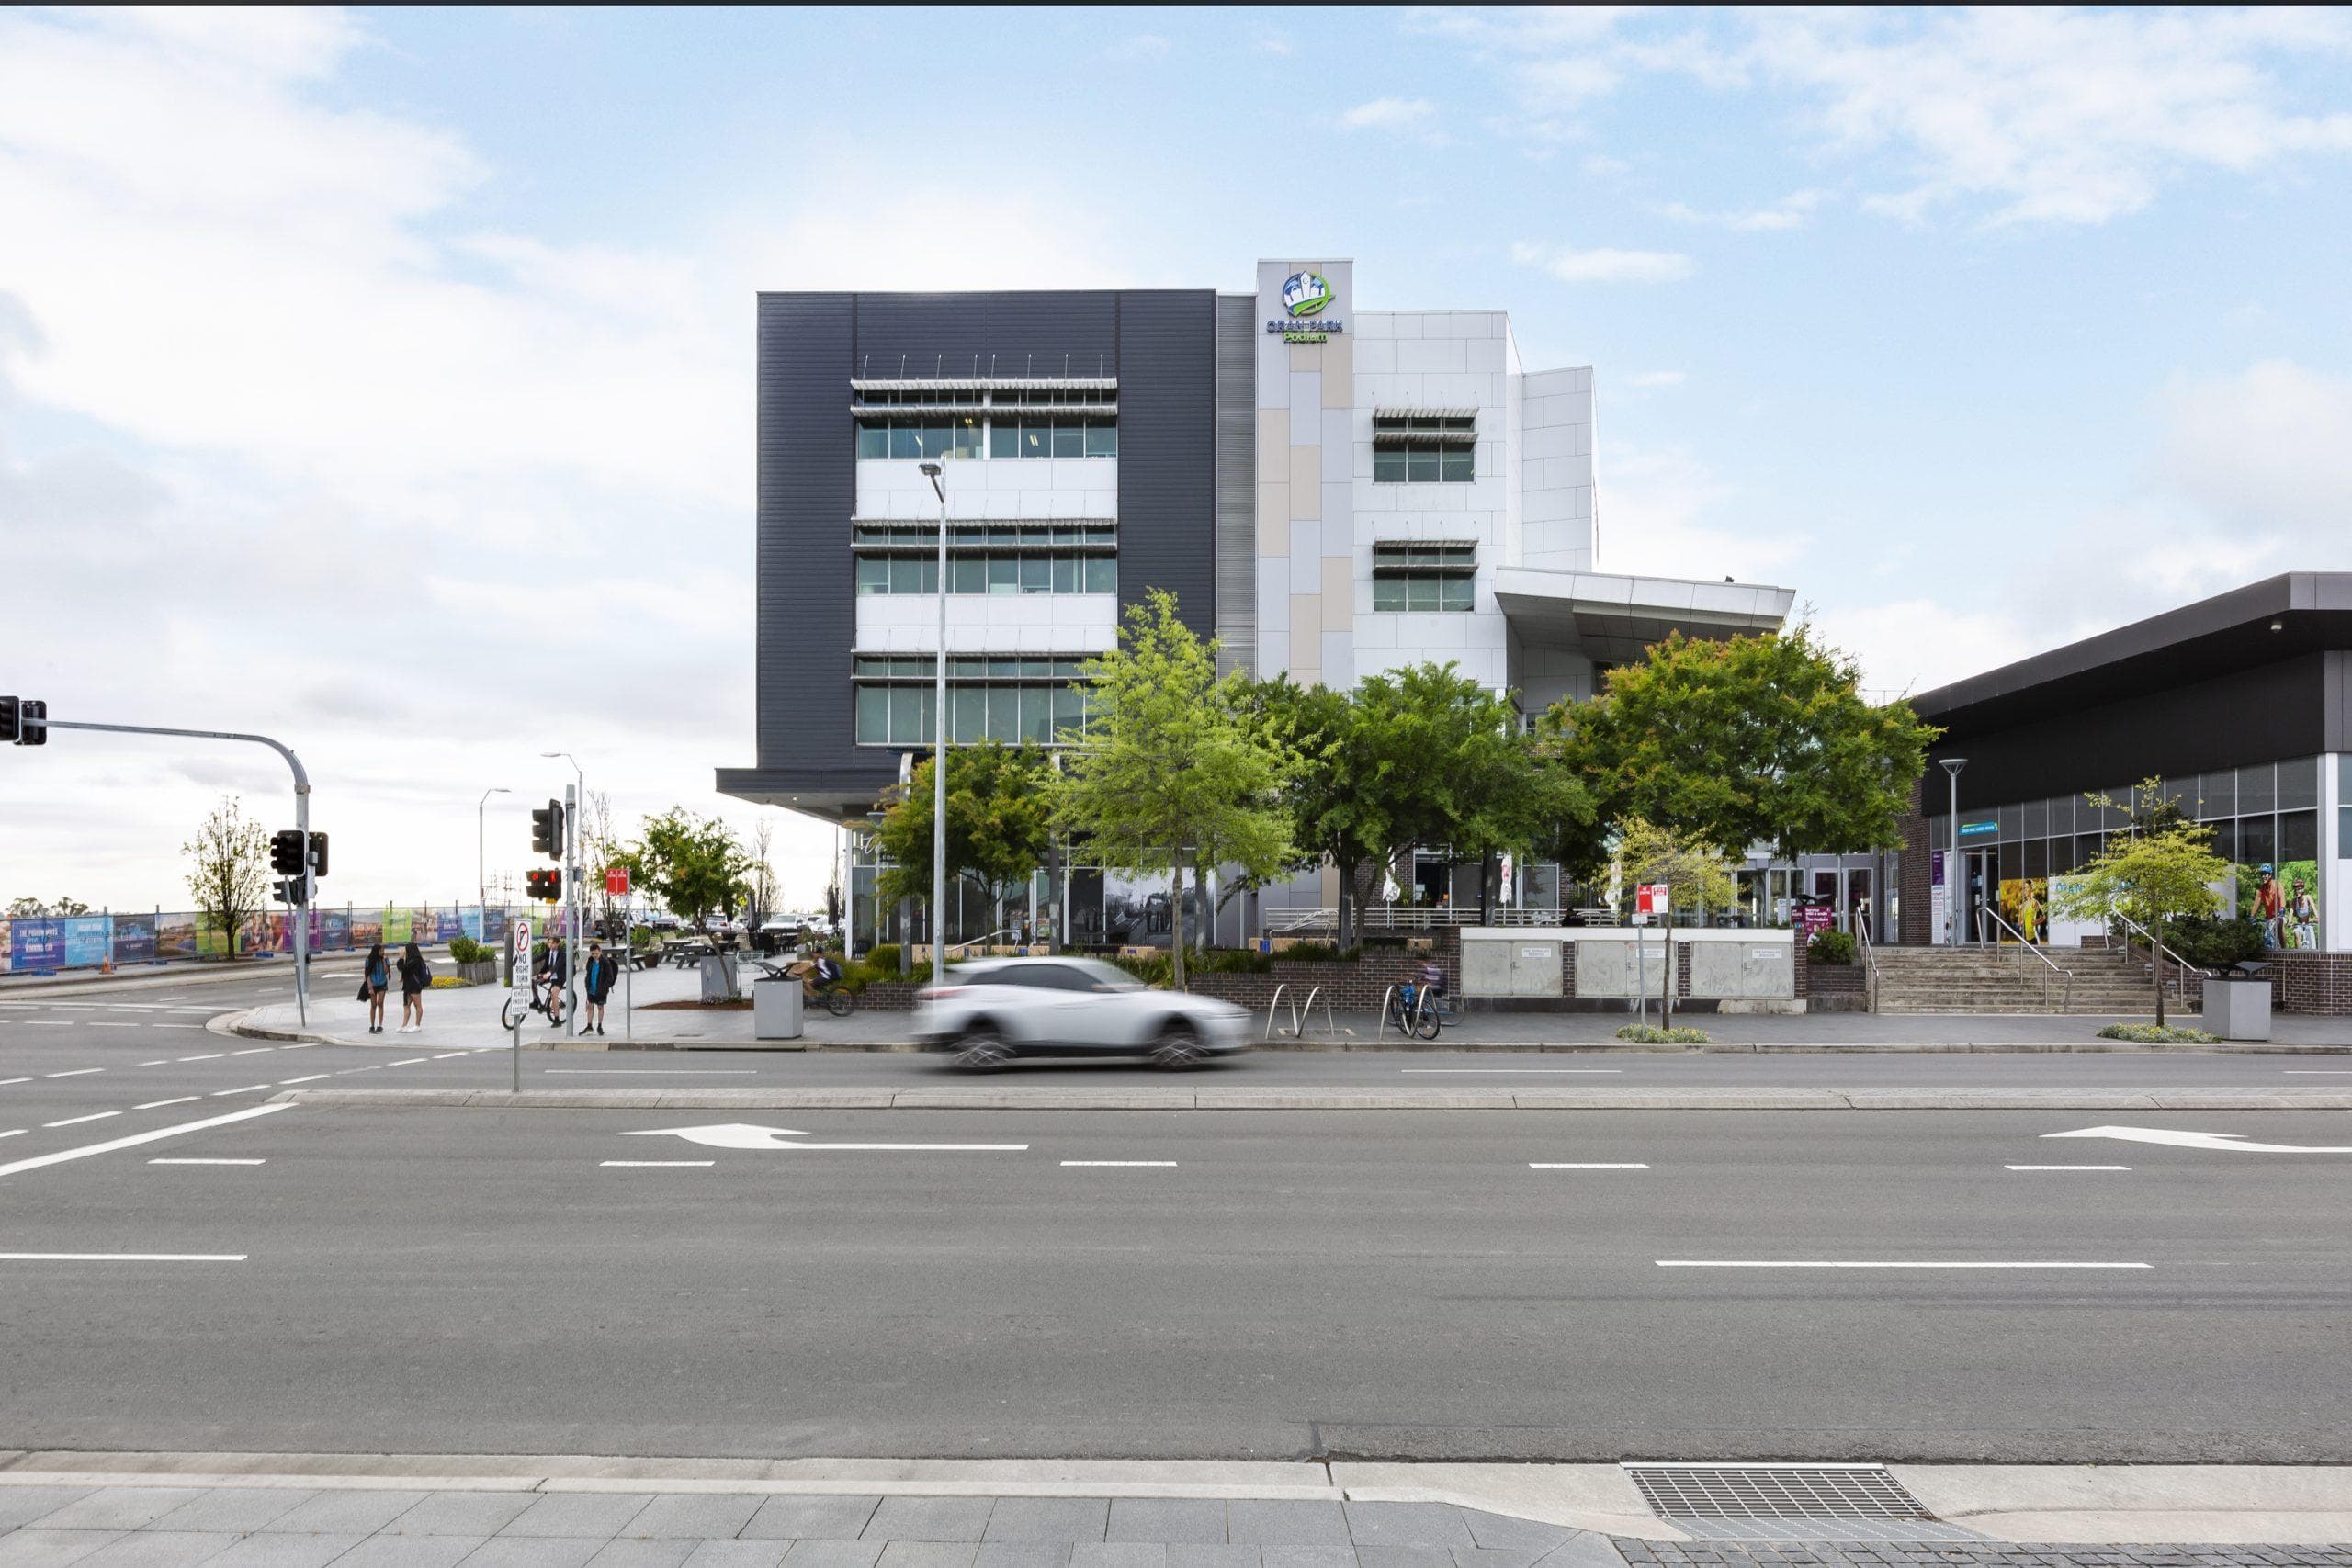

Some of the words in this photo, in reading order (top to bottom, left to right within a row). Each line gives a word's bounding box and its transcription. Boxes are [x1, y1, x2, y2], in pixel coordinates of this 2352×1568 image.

[1266, 320, 1305, 332] ORAN
[1309, 320, 1343, 332] PARK
[518, 953, 526, 964] NO
[515, 965, 529, 974] RIGHT
